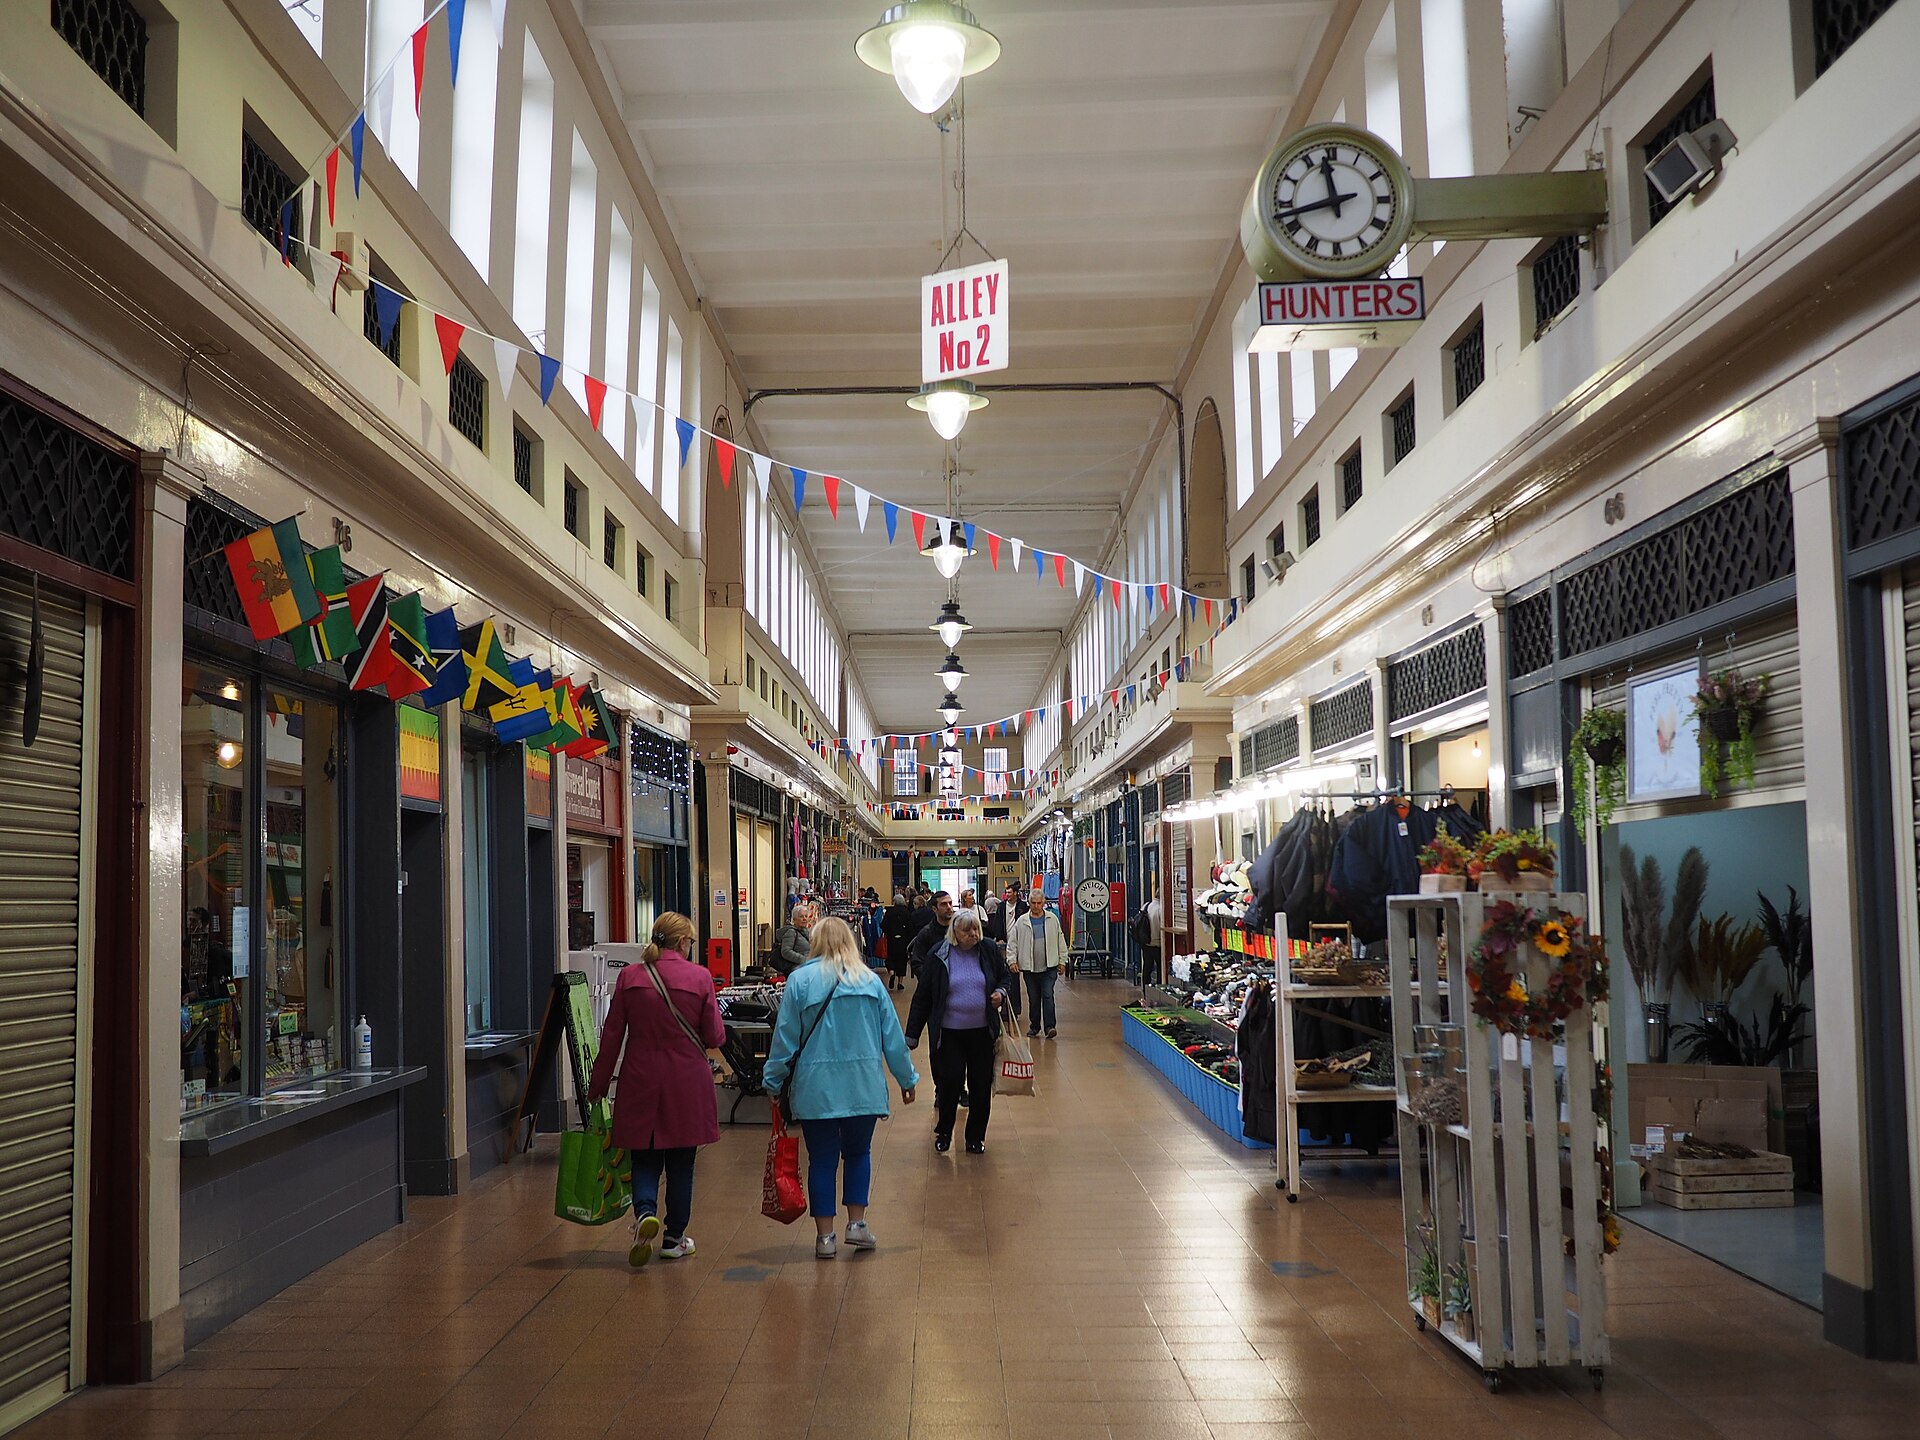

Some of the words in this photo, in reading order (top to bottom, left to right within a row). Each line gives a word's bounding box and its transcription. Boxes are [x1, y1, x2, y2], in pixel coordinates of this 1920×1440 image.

[930, 272, 1000, 327] ALLEY
[1265, 282, 1418, 321] HUNTERS
[939, 330, 971, 373] No
[976, 324, 991, 366] 2
[331, 516, 353, 553] 76
[1081, 881, 1105, 892] WEIGH
[1081, 898, 1105, 910] HOUSE
